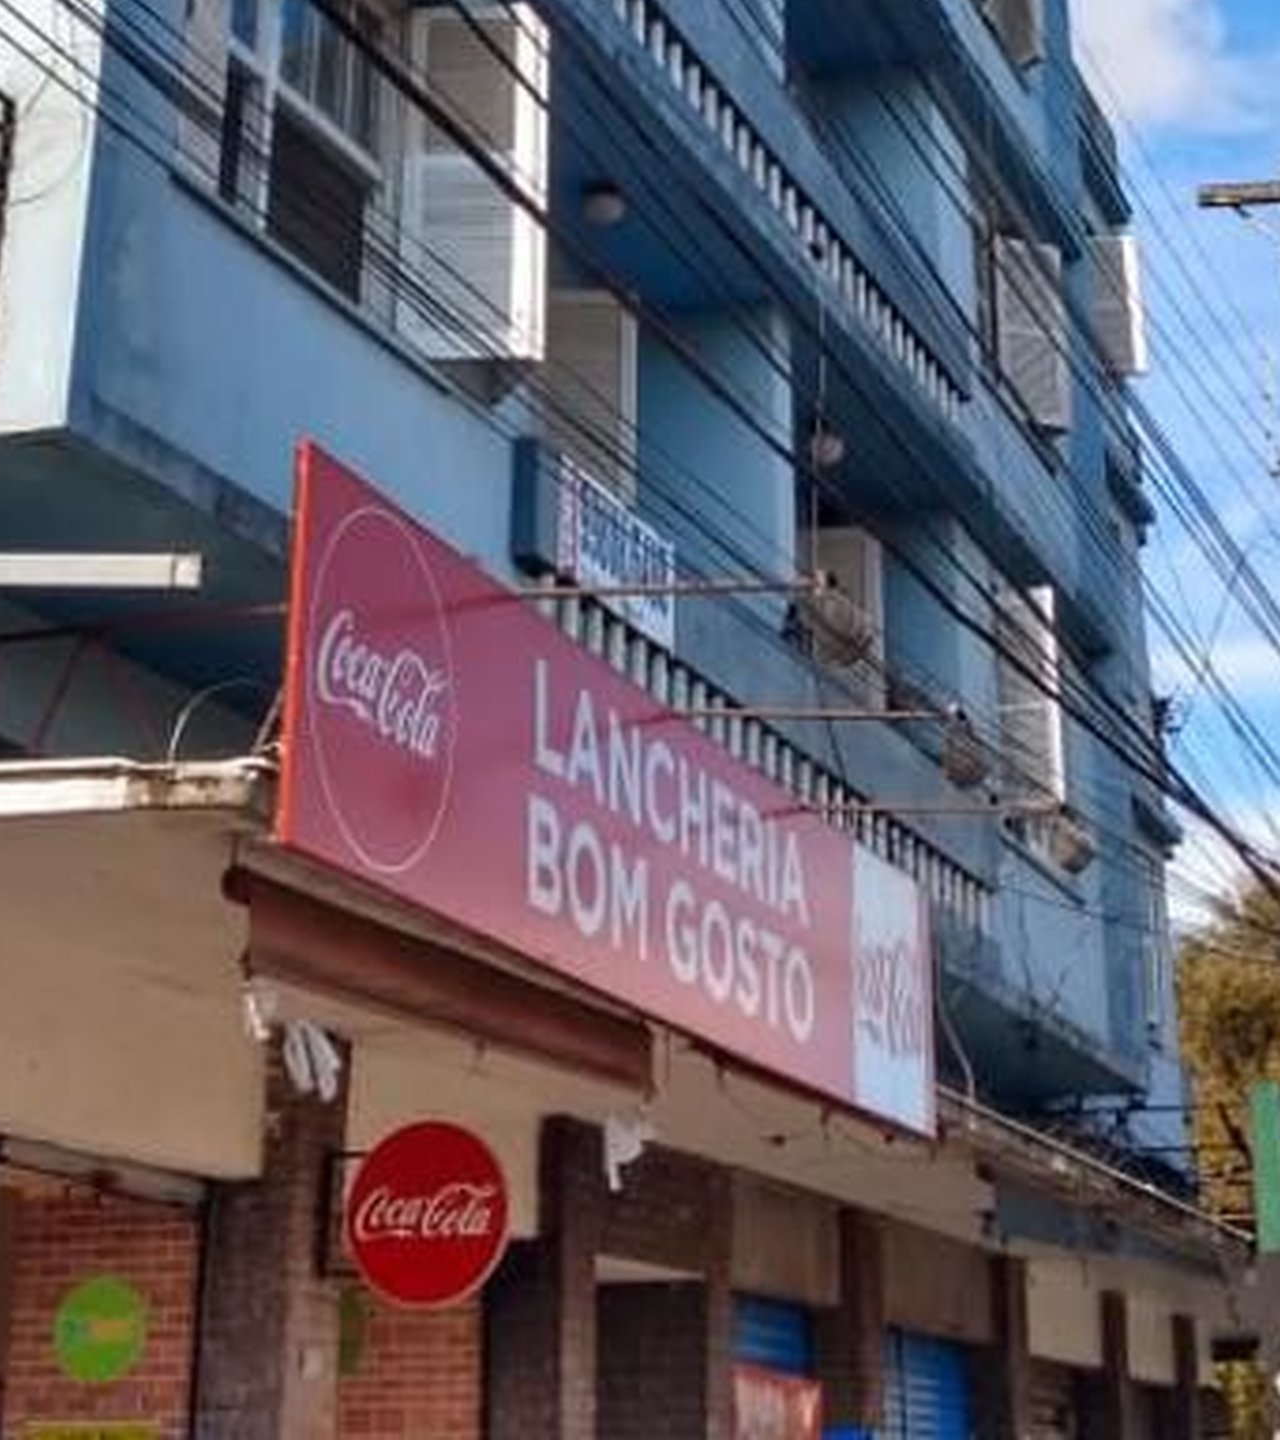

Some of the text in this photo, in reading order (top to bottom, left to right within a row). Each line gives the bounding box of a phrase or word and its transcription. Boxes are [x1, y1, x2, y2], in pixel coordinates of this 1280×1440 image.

[535, 659, 810, 927] LANCHERIA
[528, 794, 648, 962] BOM
[667, 881, 815, 1044] GOSTO
[355, 1182, 496, 1242] Coca-Cola
